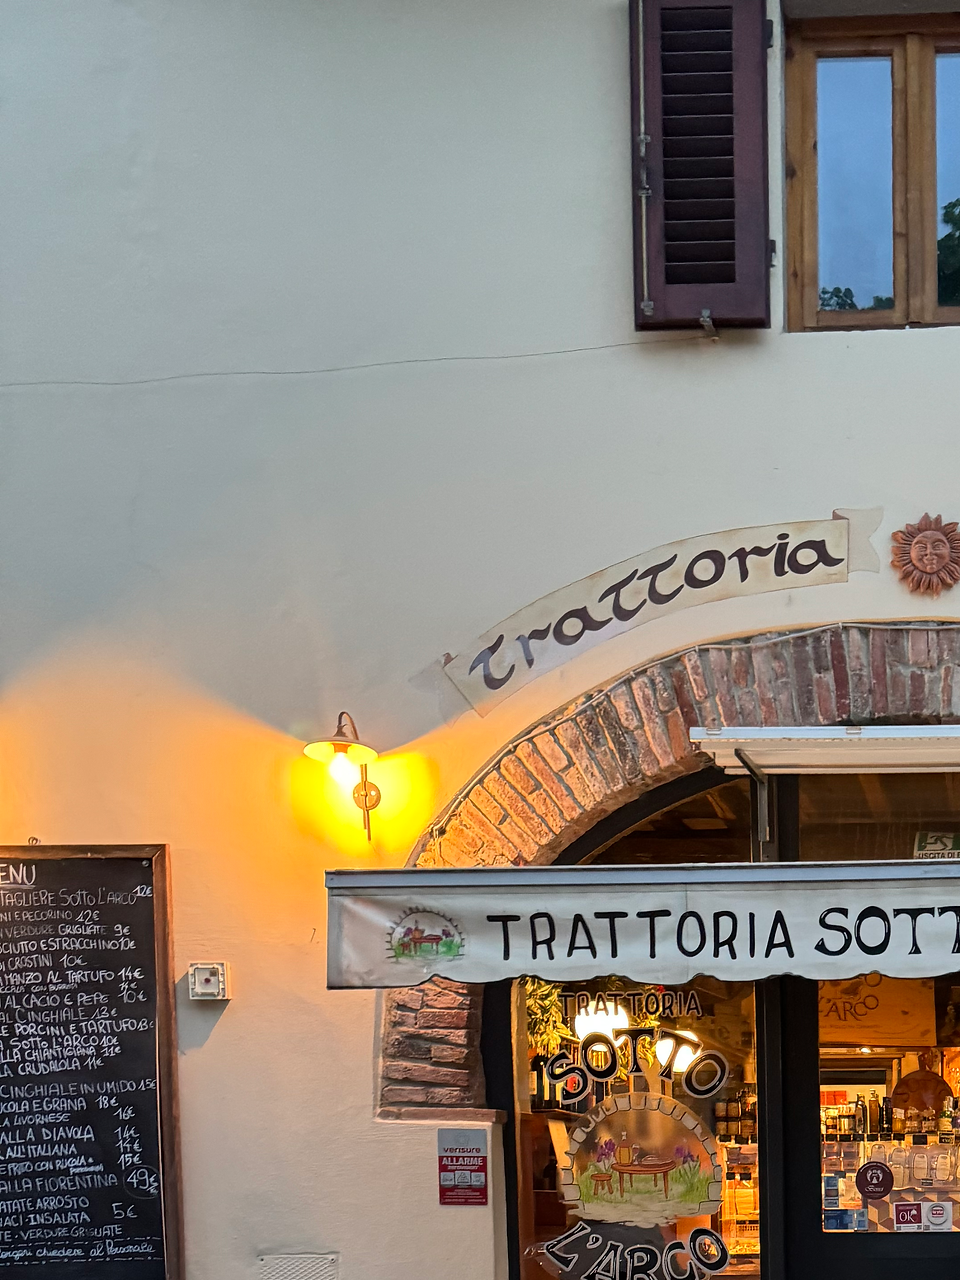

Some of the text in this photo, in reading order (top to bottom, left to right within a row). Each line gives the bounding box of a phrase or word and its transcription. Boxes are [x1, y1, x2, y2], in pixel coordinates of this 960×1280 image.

[132, 885, 153, 897] 12€
[22, 909, 72, 921] PECORINO
[75, 909, 100, 924] 12€
[5, 924, 131, 938] VERDURE GRIGLIATE 9€
[486, 909, 795, 961] TRATTORIA
[48, 937, 118, 951] STRACCHINO
[118, 937, 136, 950] 10€
[8, 953, 87, 970] CROSTINI 10€
[4, 966, 144, 985] MANZO AL TARTUFO 14€
[4, 994, 21, 1009] AL
[23, 993, 60, 1008] CACIO
[77, 992, 110, 1005] PEPE
[118, 989, 147, 1003] 10€
[559, 990, 702, 1018] TRATTORIA
[15, 1008, 89, 1023] CINGHIALE
[15, 1023, 65, 1036] PORCINI
[70, 1024, 78, 1035] E
[79, 1018, 137, 1034] TARTUFO
[53, 1035, 98, 1049] L'ARCO
[100, 1035, 119, 1047] 10€
[25, 1046, 96, 1063] CHIANTIGIANA
[546, 1027, 730, 1104] SOTTO
[81, 1083, 94, 1095] IN
[97, 1080, 136, 1094] UMIDO
[43, 1097, 87, 1111] GRANA
[95, 1095, 119, 1110] 18€
[13, 1112, 71, 1126] LIVORNESE
[42, 1125, 95, 1142] DIAVOLA
[115, 1139, 143, 1153] 14€
[117, 1153, 143, 1170] 15€
[442, 1157, 483, 1166] ALLARME
[35, 1173, 118, 1192] FIORENTINA
[36, 1194, 90, 1210] ARROSTO
[112, 1202, 138, 1219] 5€
[20, 1226, 69, 1241] VERDURE
[36, 1247, 85, 1257] chiedere
